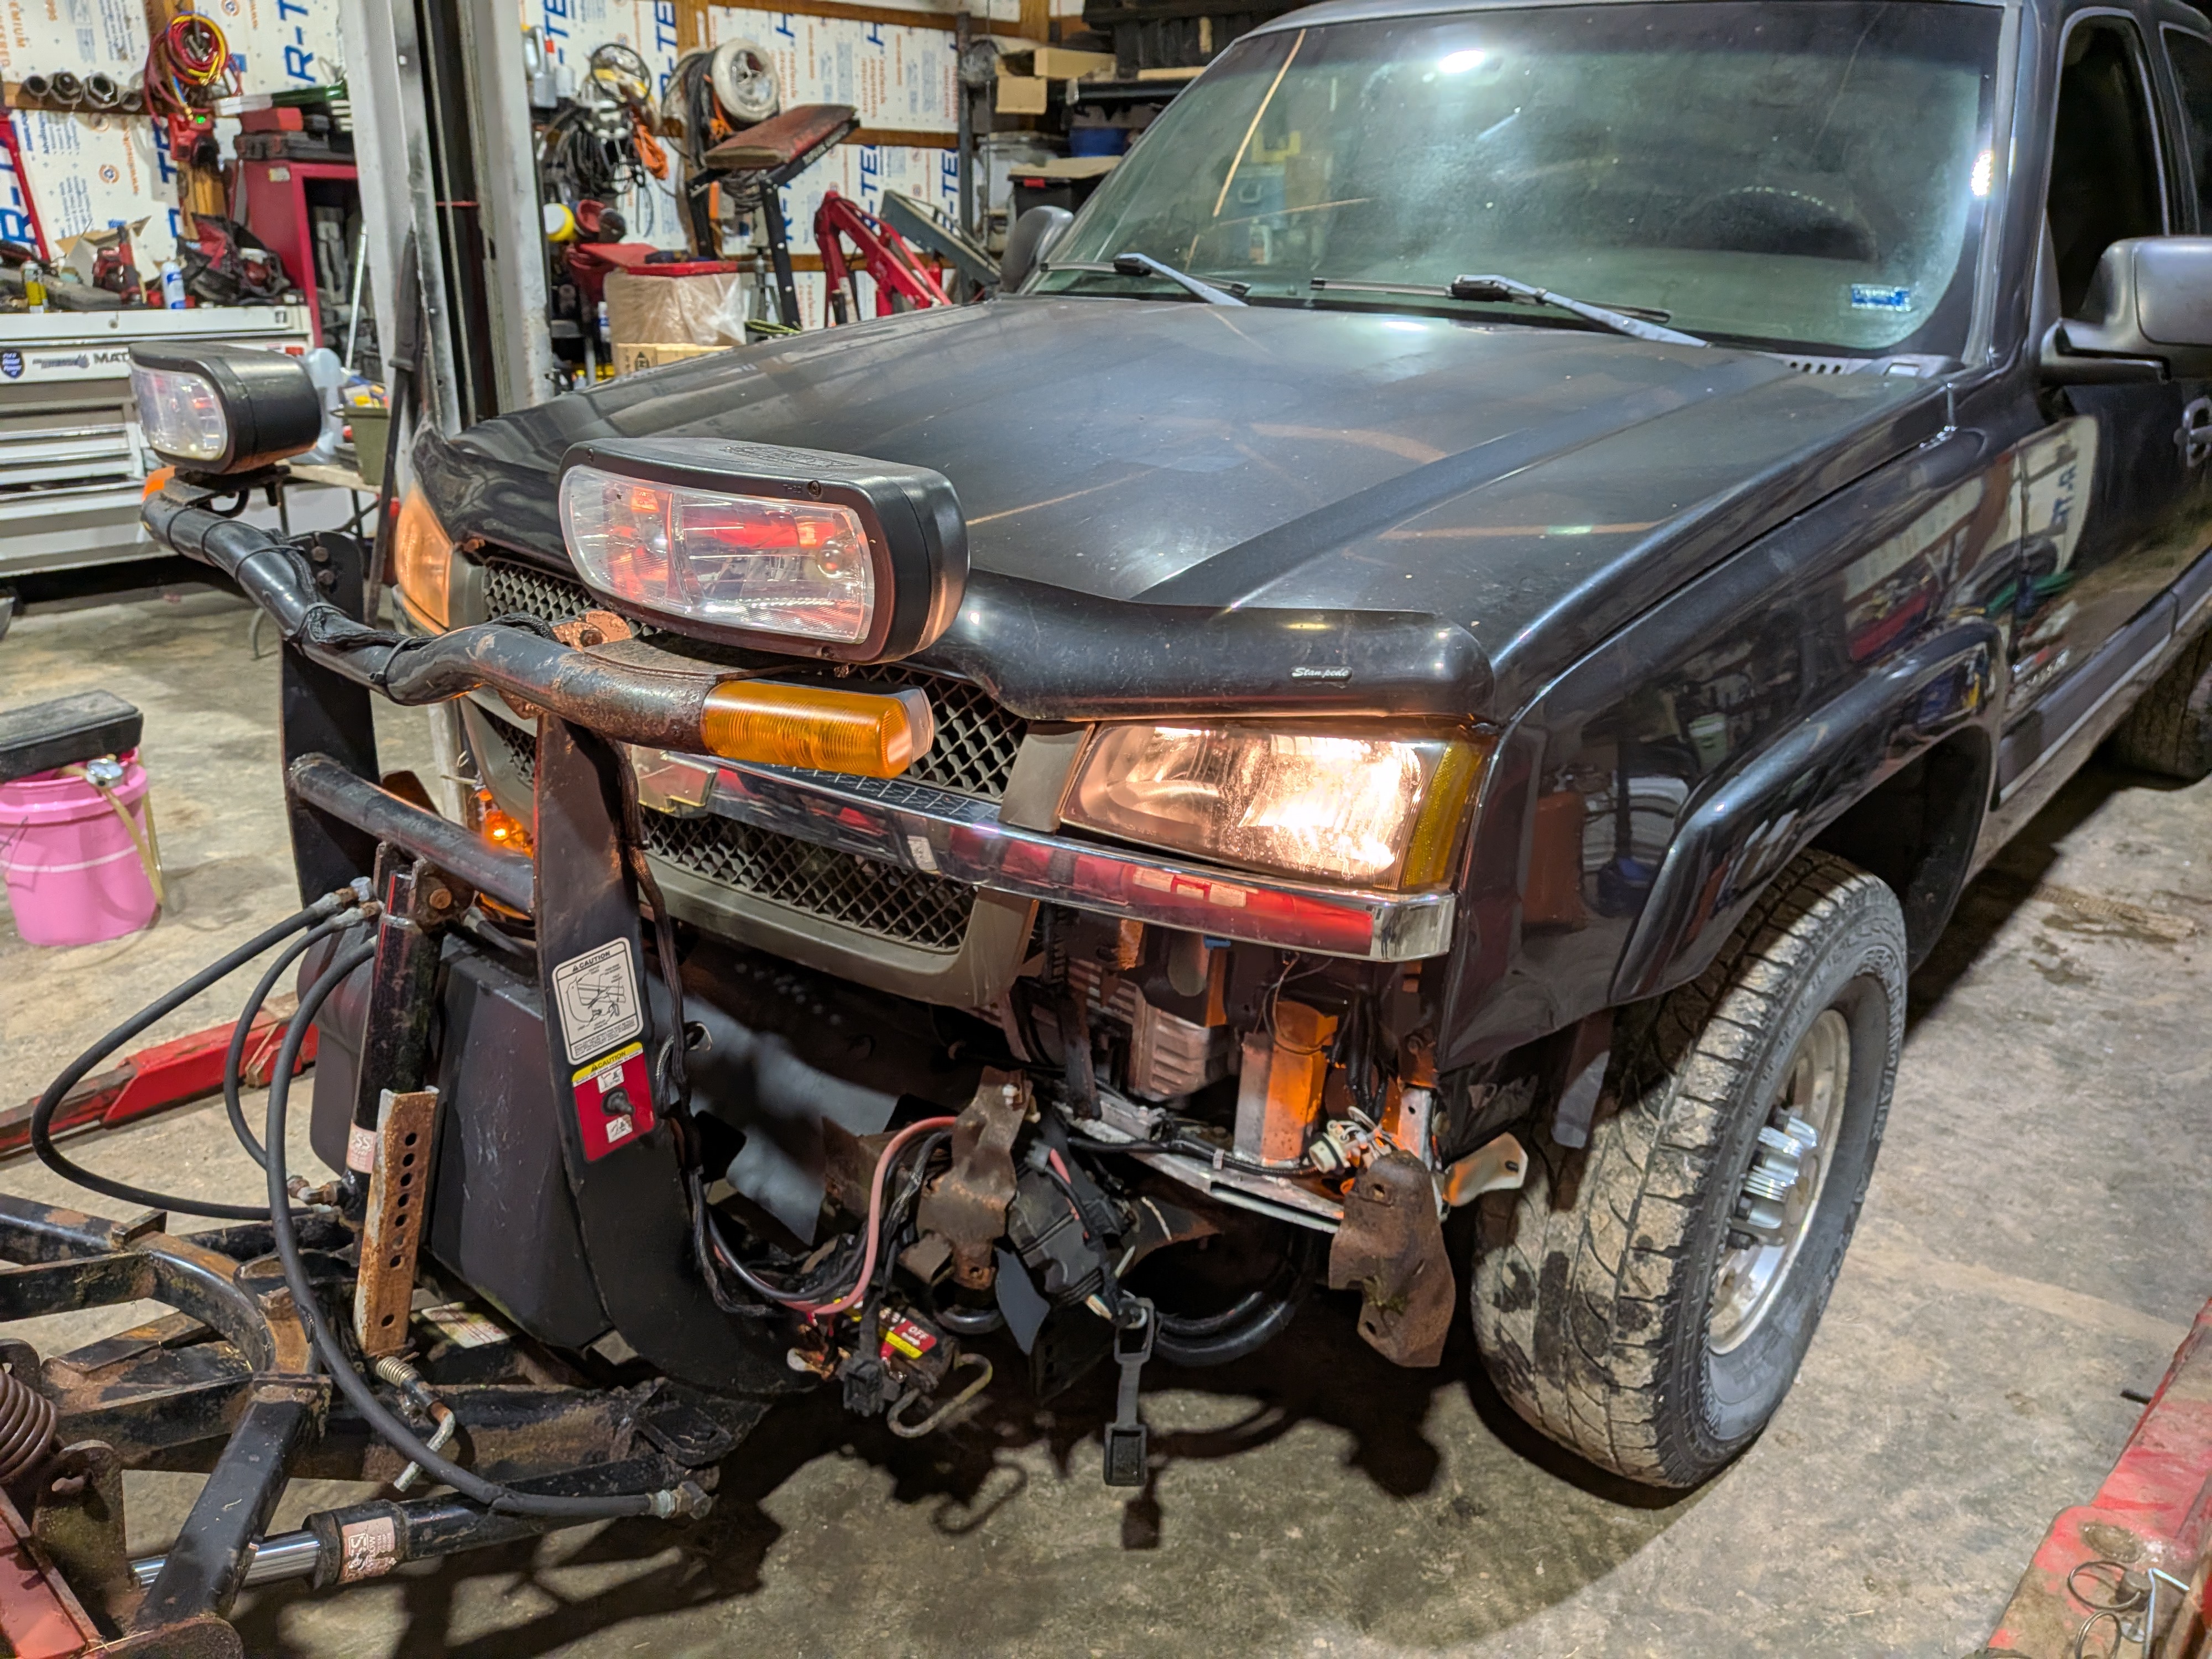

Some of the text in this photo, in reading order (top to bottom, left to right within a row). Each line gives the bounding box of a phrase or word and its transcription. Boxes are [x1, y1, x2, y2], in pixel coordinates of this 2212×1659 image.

[1292, 666, 1349, 679] Stampede
[578, 951, 611, 970] CAUTION
[597, 1050, 627, 1069] CAUTION
